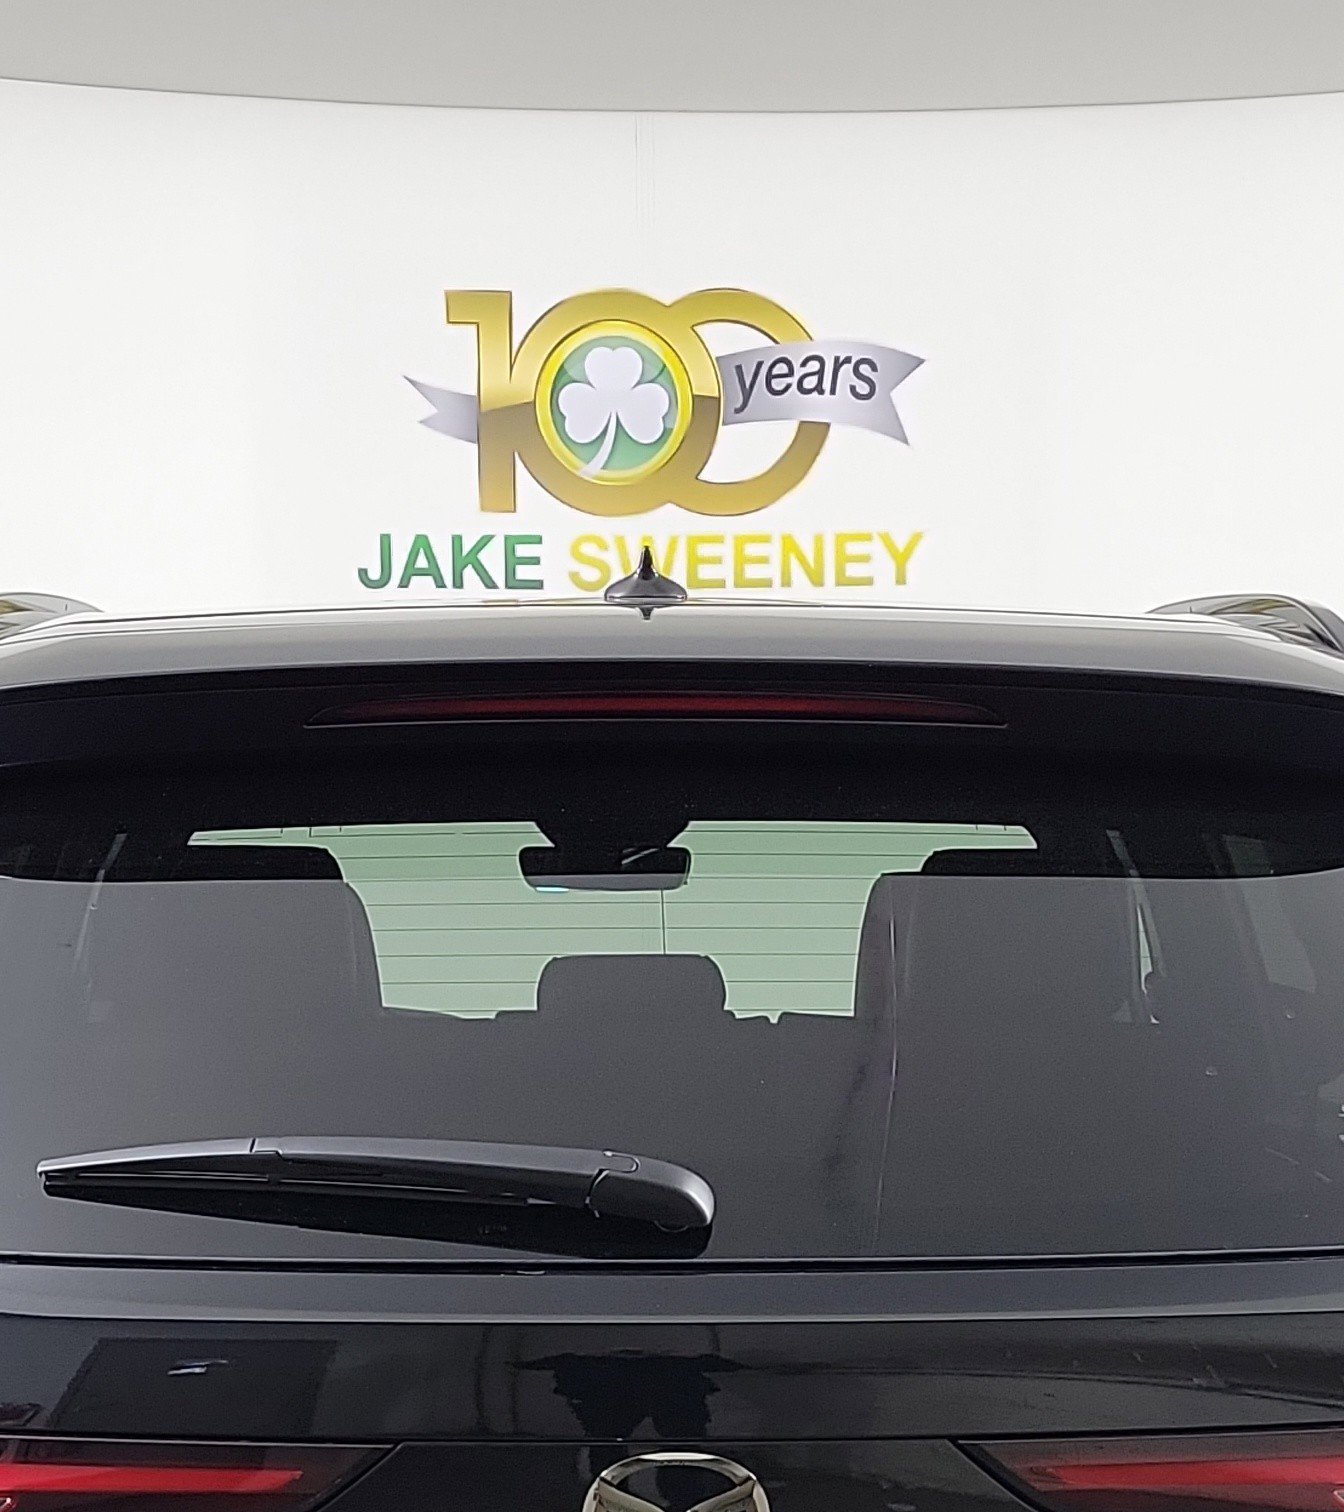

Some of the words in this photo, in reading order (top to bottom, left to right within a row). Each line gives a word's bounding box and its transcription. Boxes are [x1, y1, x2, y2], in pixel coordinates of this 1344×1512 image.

[444, 287, 832, 517] 100
[732, 353, 879, 415] years
[356, 533, 544, 590] JAKE
[568, 531, 923, 593] SWEENEY
